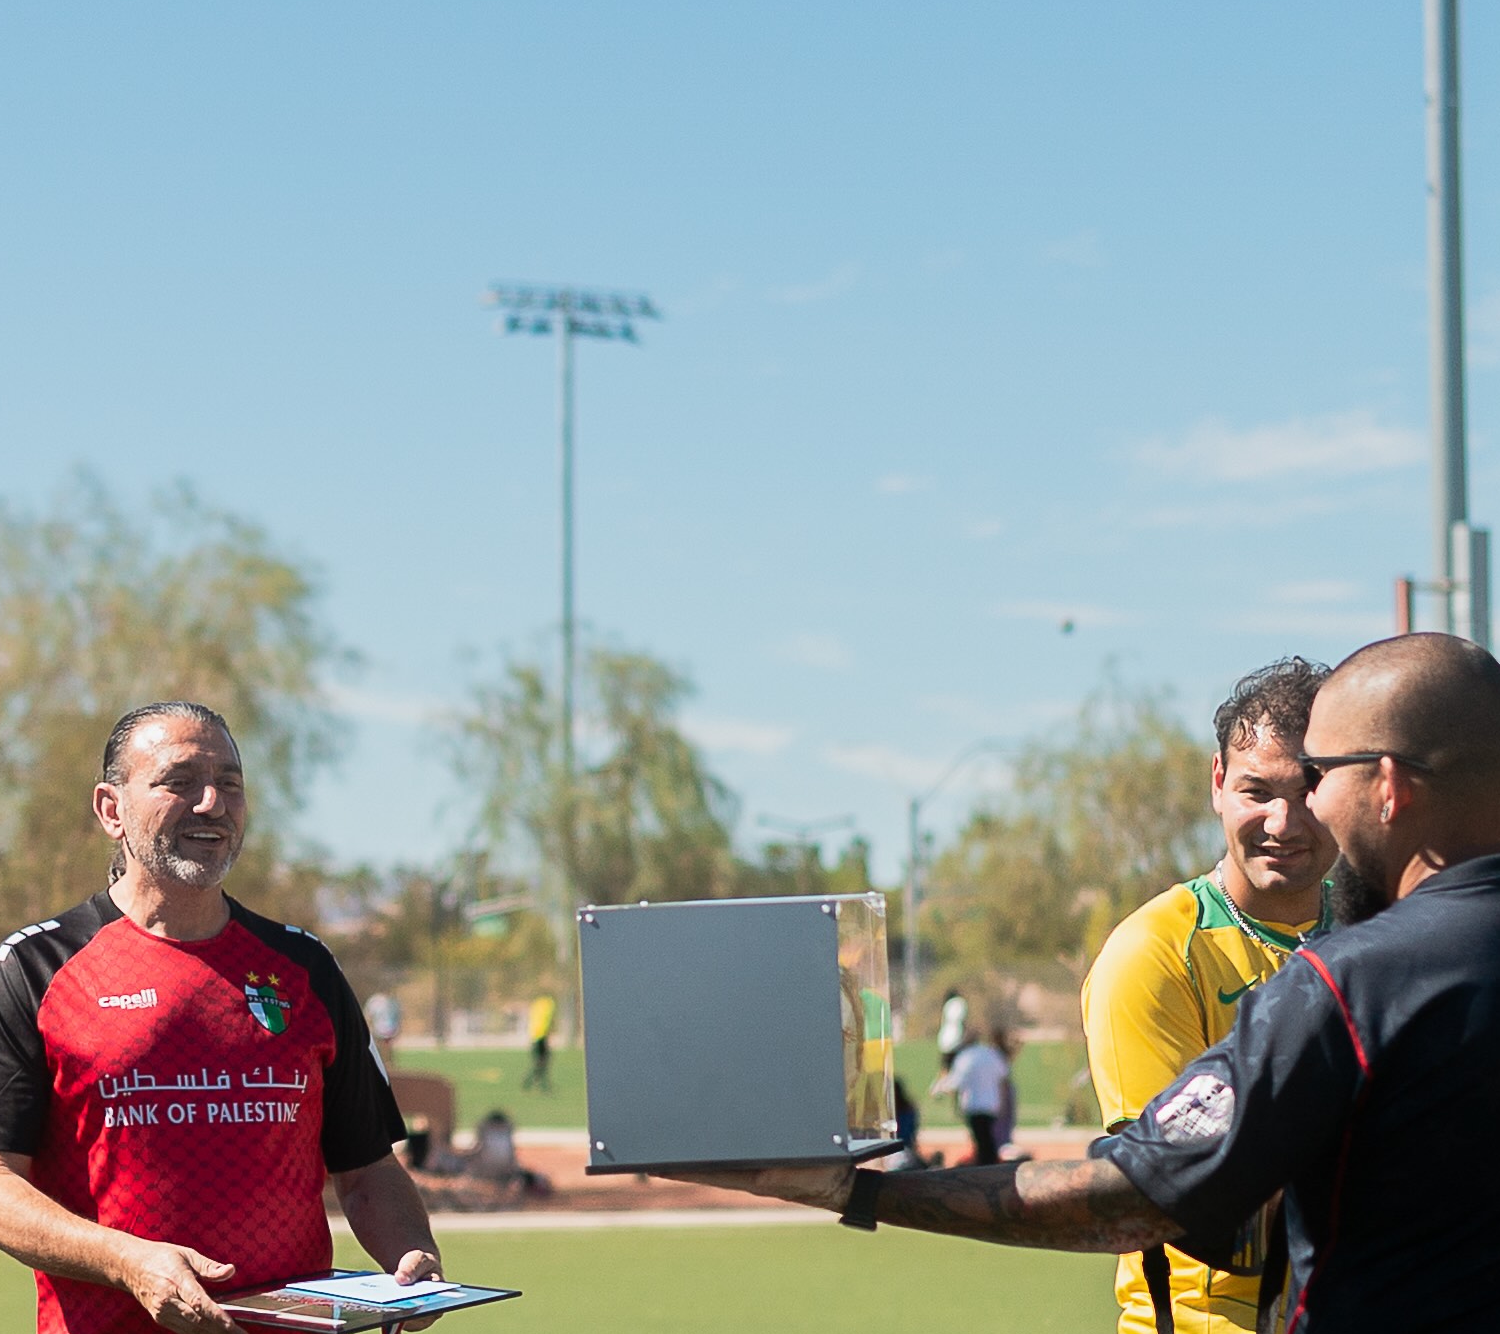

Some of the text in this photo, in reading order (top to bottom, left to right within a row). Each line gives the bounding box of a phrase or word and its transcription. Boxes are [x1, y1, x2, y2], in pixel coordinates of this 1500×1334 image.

[98, 988, 158, 1009] capelli
[99, 1067, 308, 1099] بنك فلسطين
[104, 1101, 300, 1128] BANK OF PALESTINE
